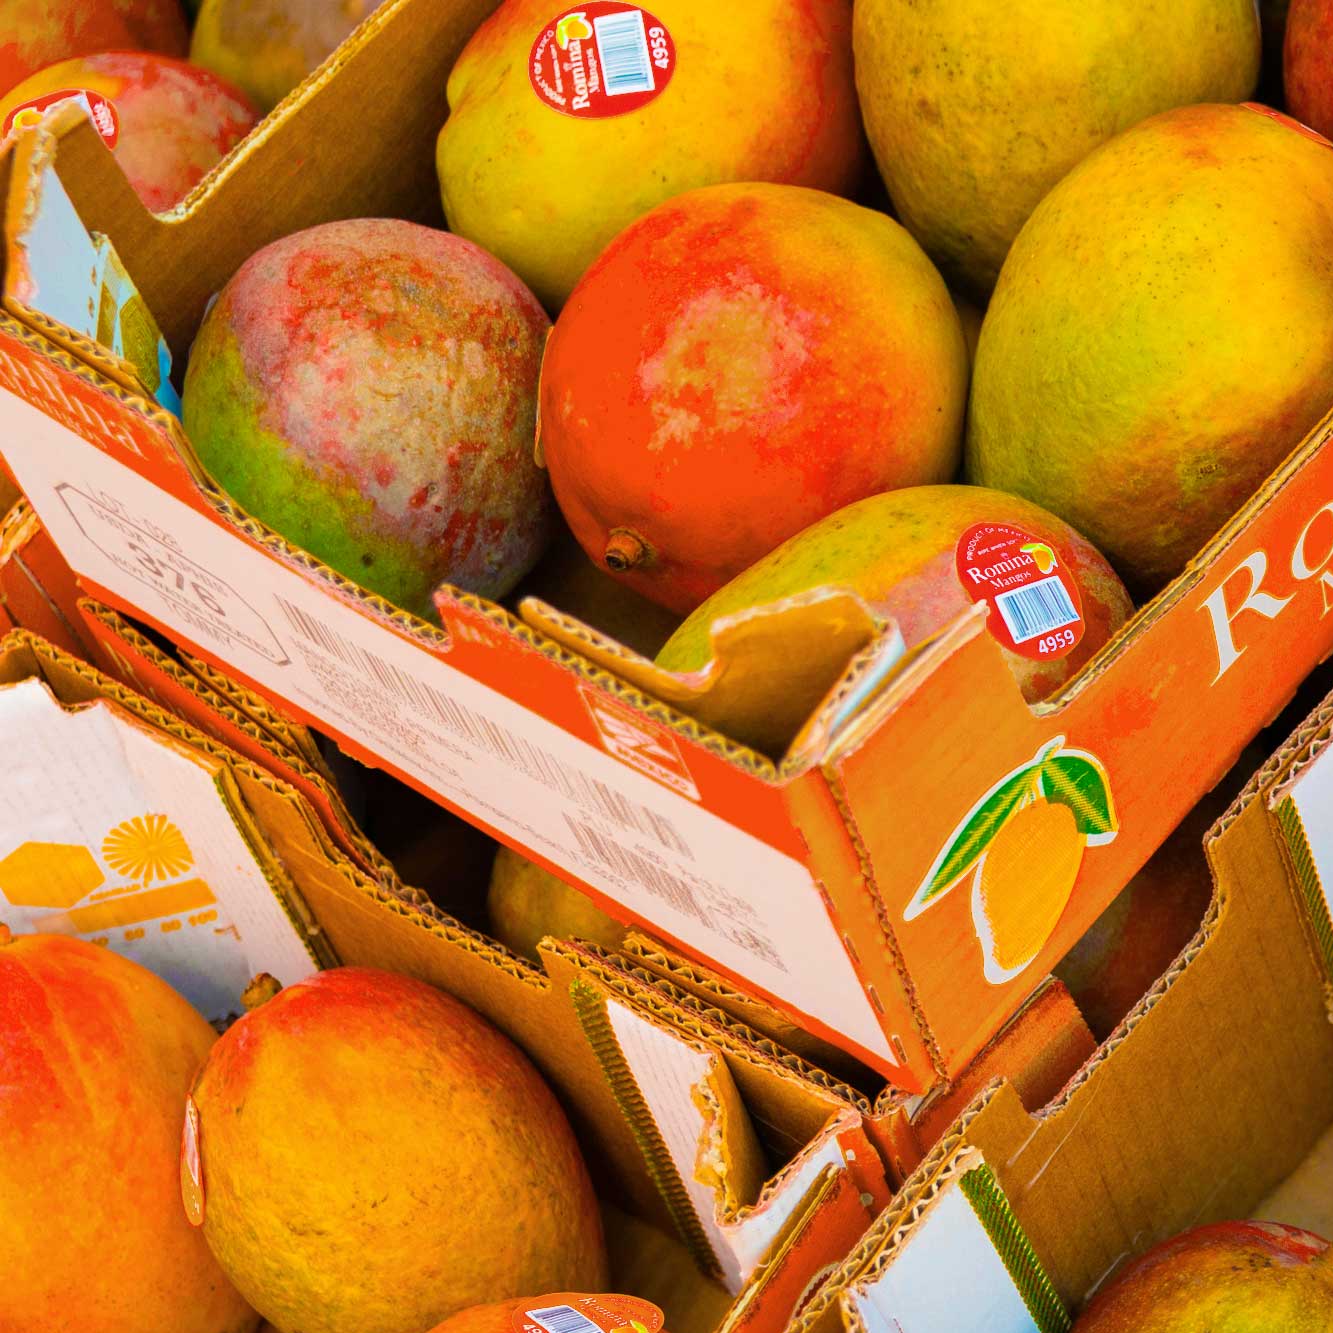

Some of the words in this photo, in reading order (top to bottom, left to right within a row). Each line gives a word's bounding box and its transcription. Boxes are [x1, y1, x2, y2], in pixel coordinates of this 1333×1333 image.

[648, 26, 669, 69] 4959
[569, 40, 590, 110] Romina
[586, 48, 600, 93] Mangos
[0, 351, 149, 461] mina
[966, 530, 984, 561] PRODUCT
[128, 541, 226, 616] 376
[966, 554, 1035, 584] Romina
[990, 571, 1031, 590] Mangos
[1039, 629, 1075, 654] 4959
